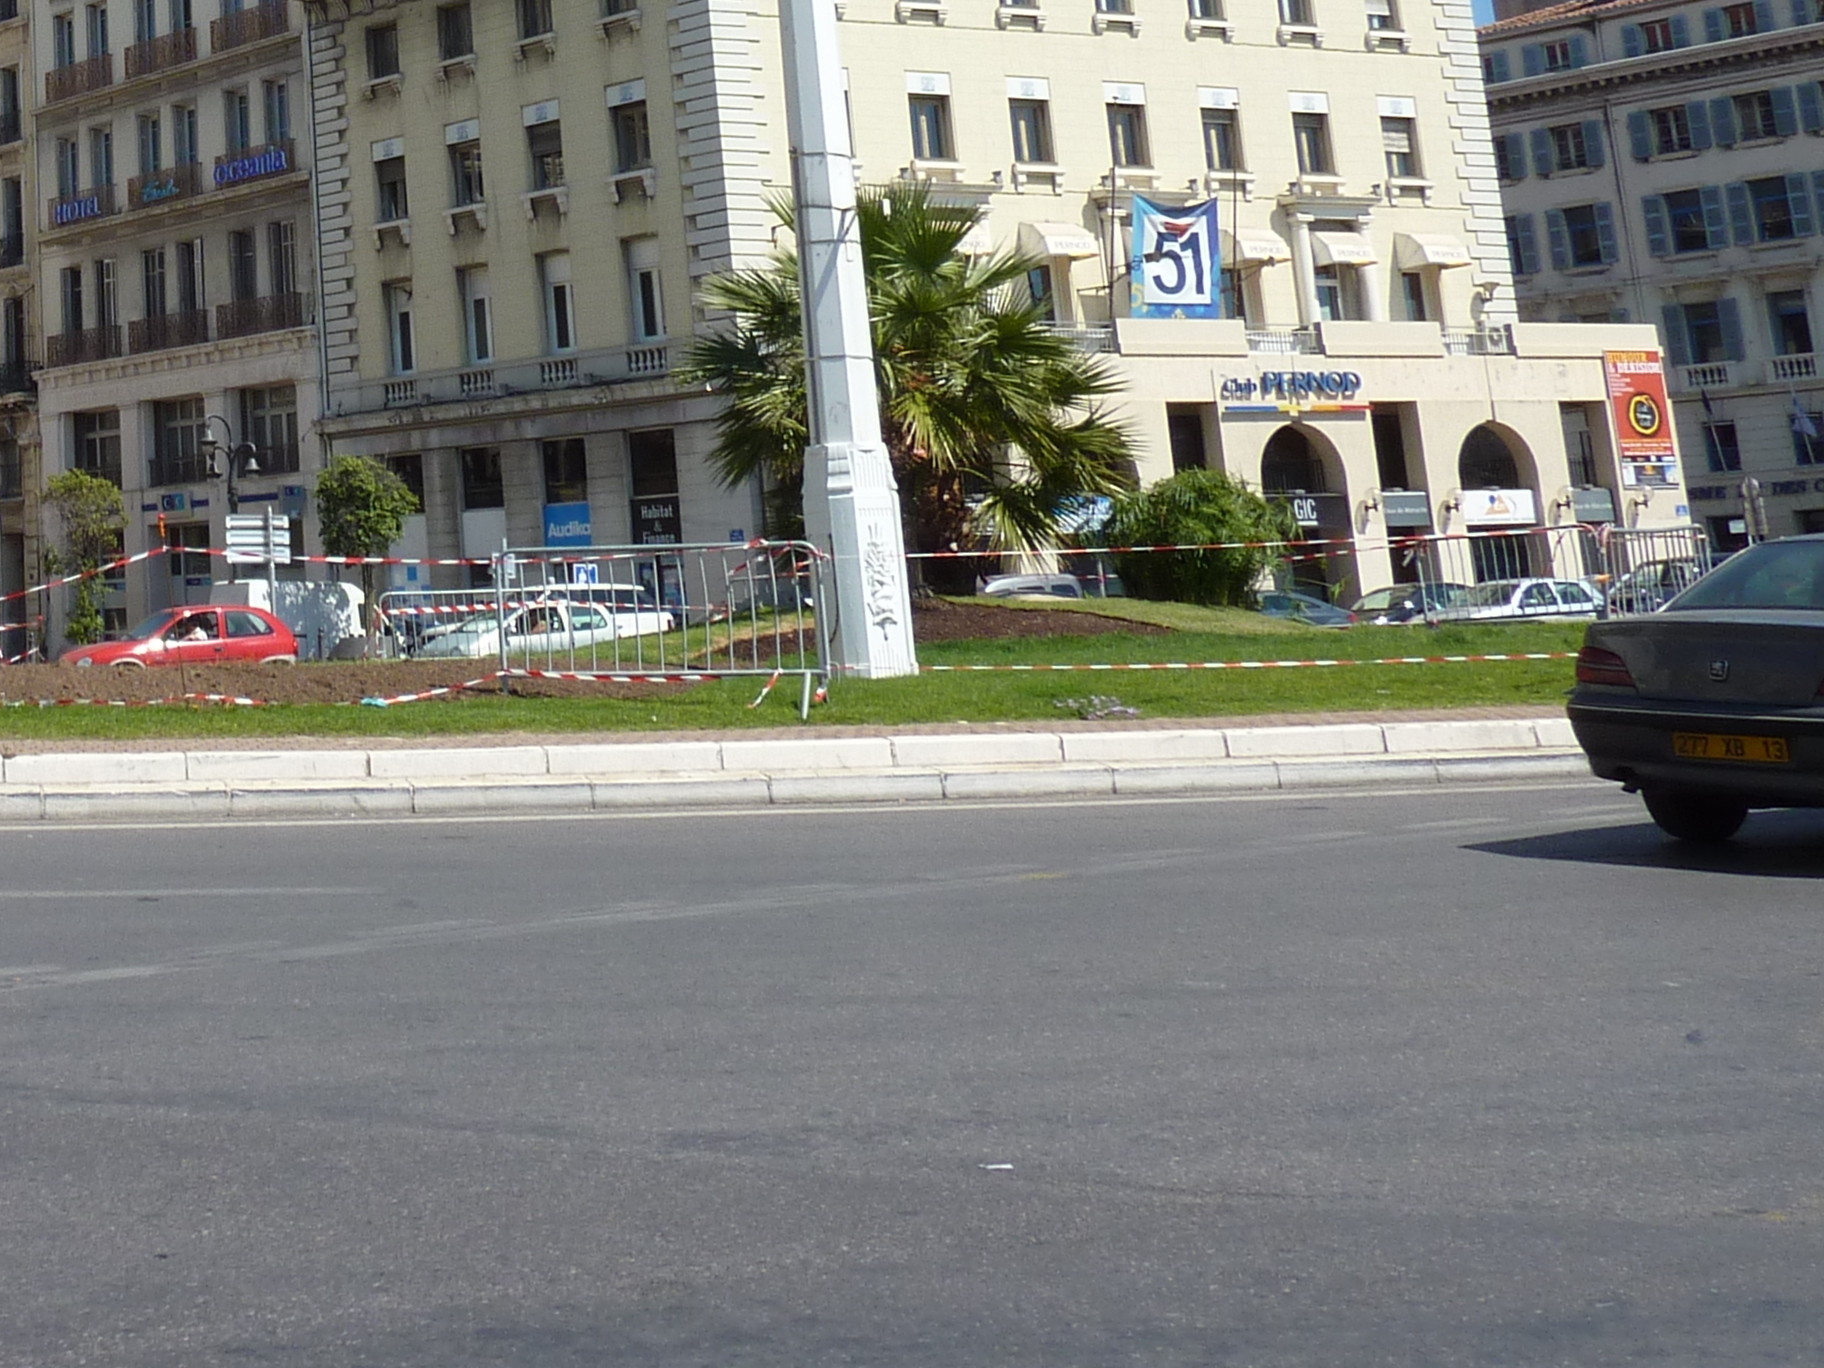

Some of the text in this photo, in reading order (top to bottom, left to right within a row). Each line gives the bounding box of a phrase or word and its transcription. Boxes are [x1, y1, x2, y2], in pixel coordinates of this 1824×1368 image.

[56, 197, 101, 224] HOTEL
[212, 146, 286, 183] oceania
[1055, 240, 1091, 250] PERNOD
[1249, 245, 1284, 254] PERNOD
[1337, 248, 1371, 257] PERNOD
[1432, 249, 1465, 258] PERNOD
[1152, 232, 1205, 295] 51
[1221, 372, 1362, 395] Club PERNOD
[641, 504, 674, 519] Habitat
[1294, 499, 1317, 520] GIC
[547, 521, 590, 538] Audika
[642, 531, 675, 544] Finance
[1678, 735, 1784, 760] 277 XB 13
